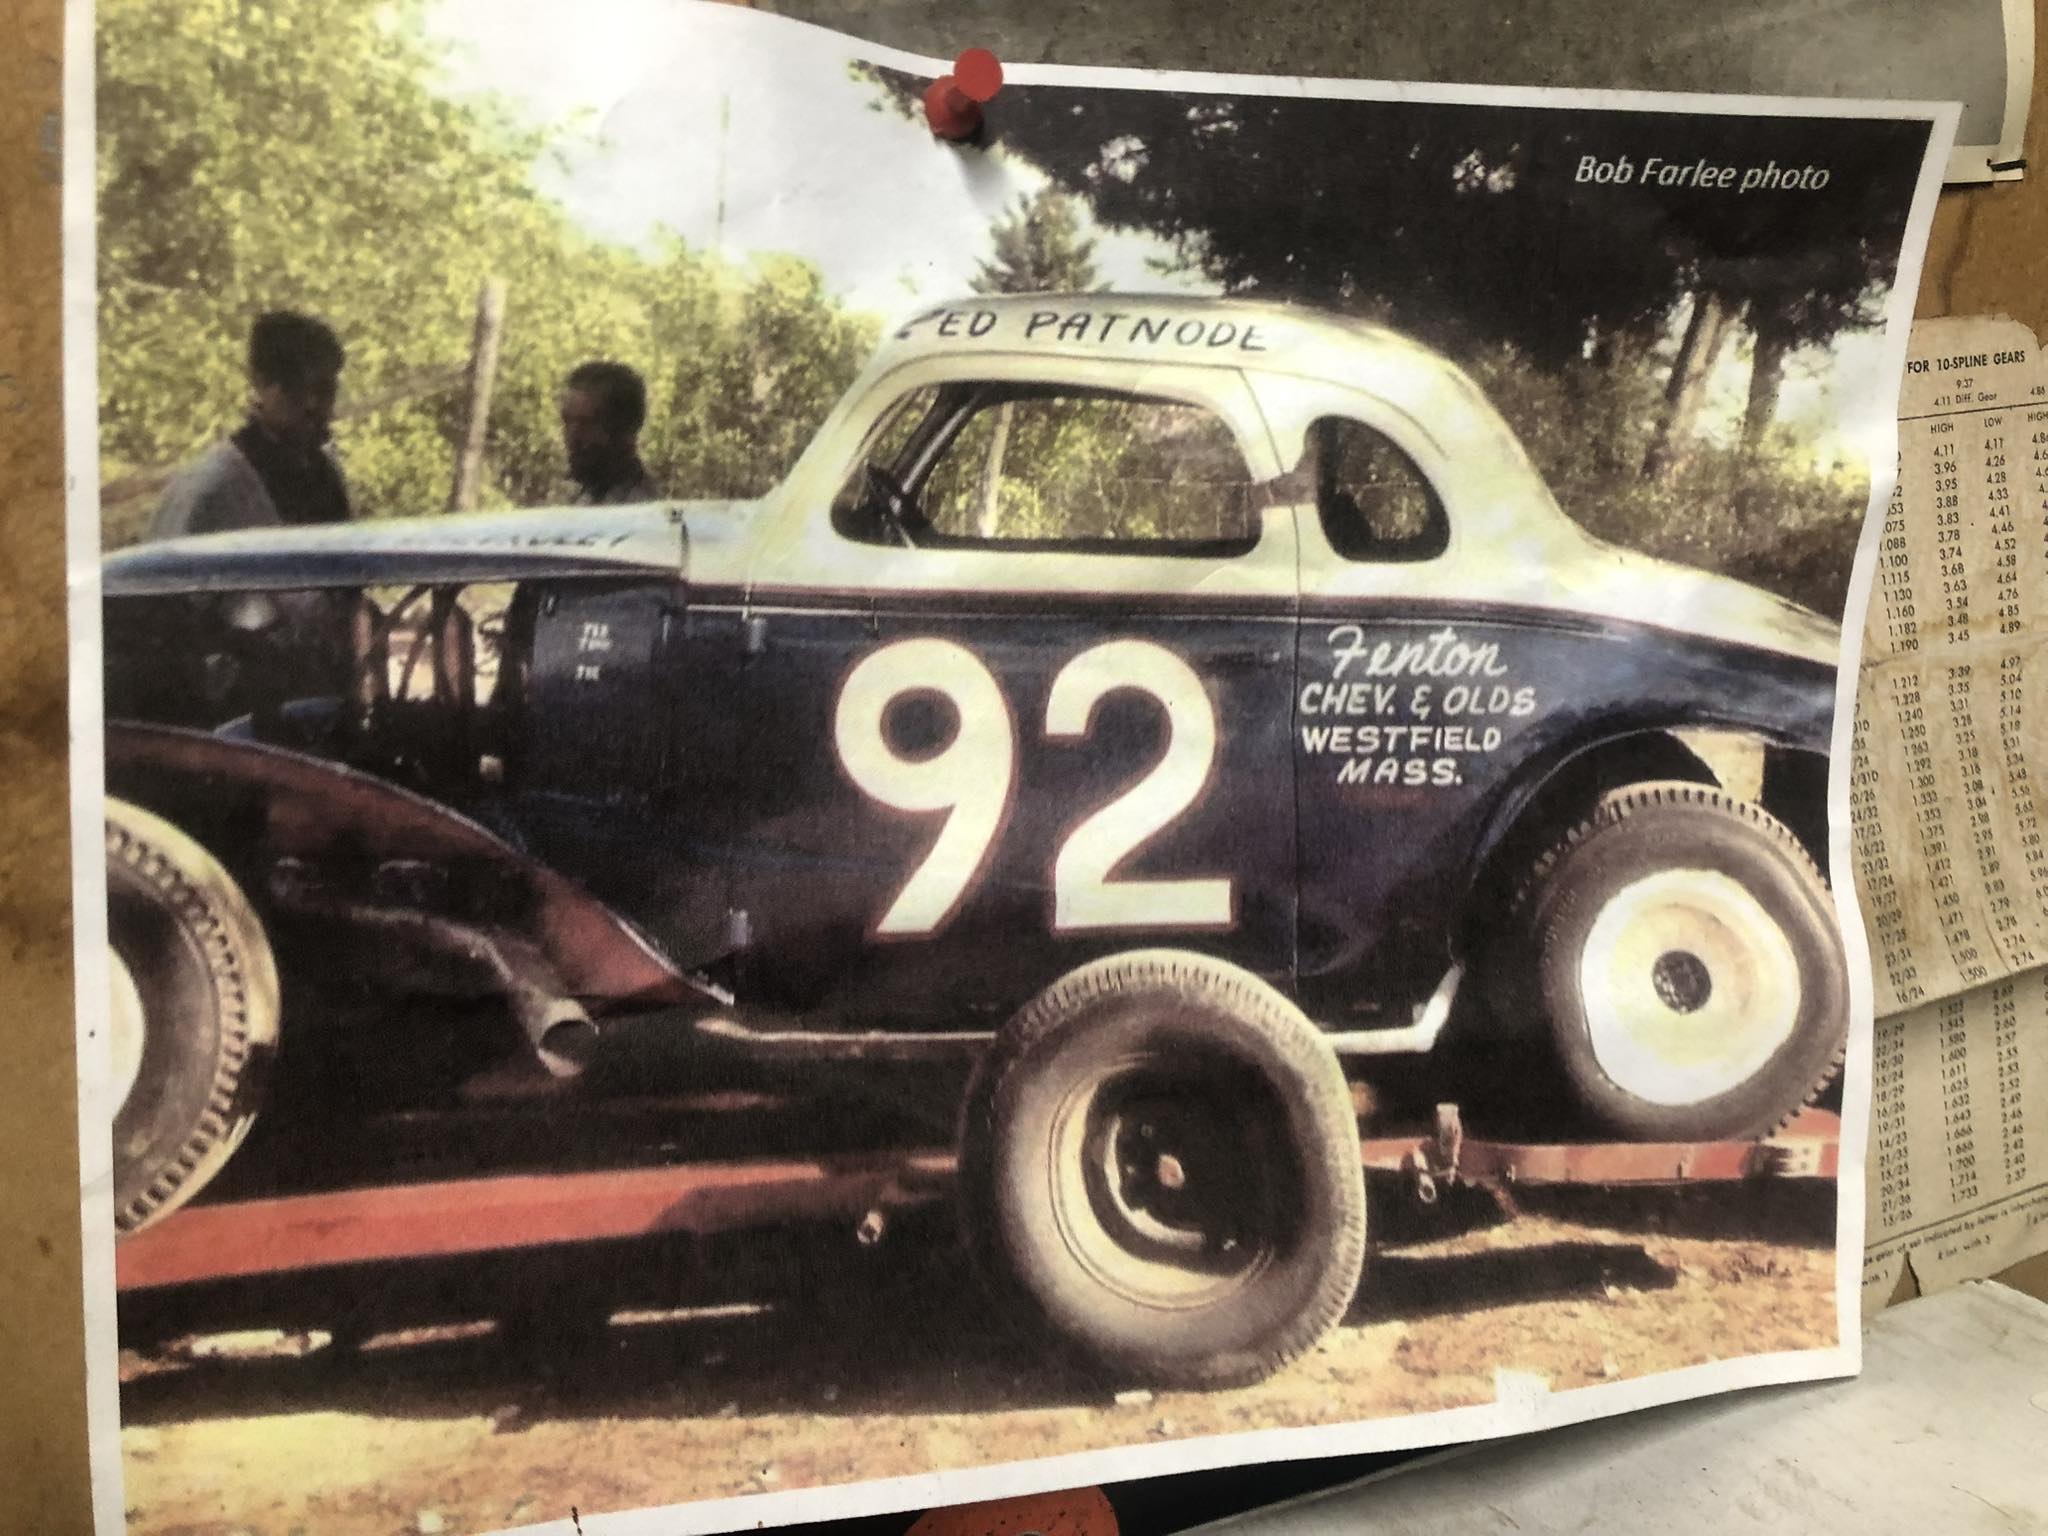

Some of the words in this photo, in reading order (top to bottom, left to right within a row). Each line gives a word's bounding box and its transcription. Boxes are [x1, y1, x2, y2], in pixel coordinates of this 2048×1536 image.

[1575, 155, 1634, 184] Bob
[1640, 157, 1737, 188] Farlee
[1739, 160, 1830, 194] photo
[1025, 311, 1267, 352] PATNODE
[1908, 362, 1929, 374] FOR
[1937, 354, 1987, 370] 10-SPLINE
[1994, 351, 2025, 365] GEARS
[1978, 392, 1997, 401] Gear
[1931, 423, 1954, 434] HIGH
[1984, 417, 2002, 428] LOW
[1934, 444, 1955, 457] 4.11
[1934, 461, 1957, 475] 3.96
[1985, 455, 2005, 467] 4.26
[1936, 478, 1957, 492] 3.95
[1987, 472, 2006, 484] 4.28
[1937, 496, 1958, 509] 3.88
[1989, 488, 2008, 501] 4.33
[1937, 513, 1959, 526] 3.83
[1990, 505, 2010, 518] 4.41
[1938, 530, 1960, 543] 3.78
[1992, 522, 2014, 534] 4.46
[1880, 554, 1908, 568] 1.100
[1939, 547, 1962, 560] 3.74
[1995, 538, 2016, 550] 4.52
[1882, 571, 1910, 585] 1.115
[1941, 563, 1964, 577] 3.68
[1997, 555, 2016, 567] 4.58
[1944, 580, 1967, 593] 3.63
[1997, 571, 2016, 584] 4.64
[1887, 605, 1914, 619] 1.160
[1946, 597, 1968, 610] 3.54
[1998, 589, 2018, 601] 4.76
[1889, 623, 1916, 636] 1.182
[1948, 613, 1968, 627] 3.48
[1999, 605, 2019, 618] 4.85
[1891, 639, 1918, 654] 1.190
[1949, 630, 1970, 644] 3.45
[2000, 621, 2020, 634] 4.89
[1328, 625, 1508, 679] Fenton
[1300, 682, 1397, 715] CHEV.
[1411, 685, 1432, 720] &
[1443, 685, 1536, 716] OLDS
[1302, 726, 1501, 753] WESTFIELD
[834, 637, 1233, 934] 92
[1337, 757, 1464, 786] MASS.
